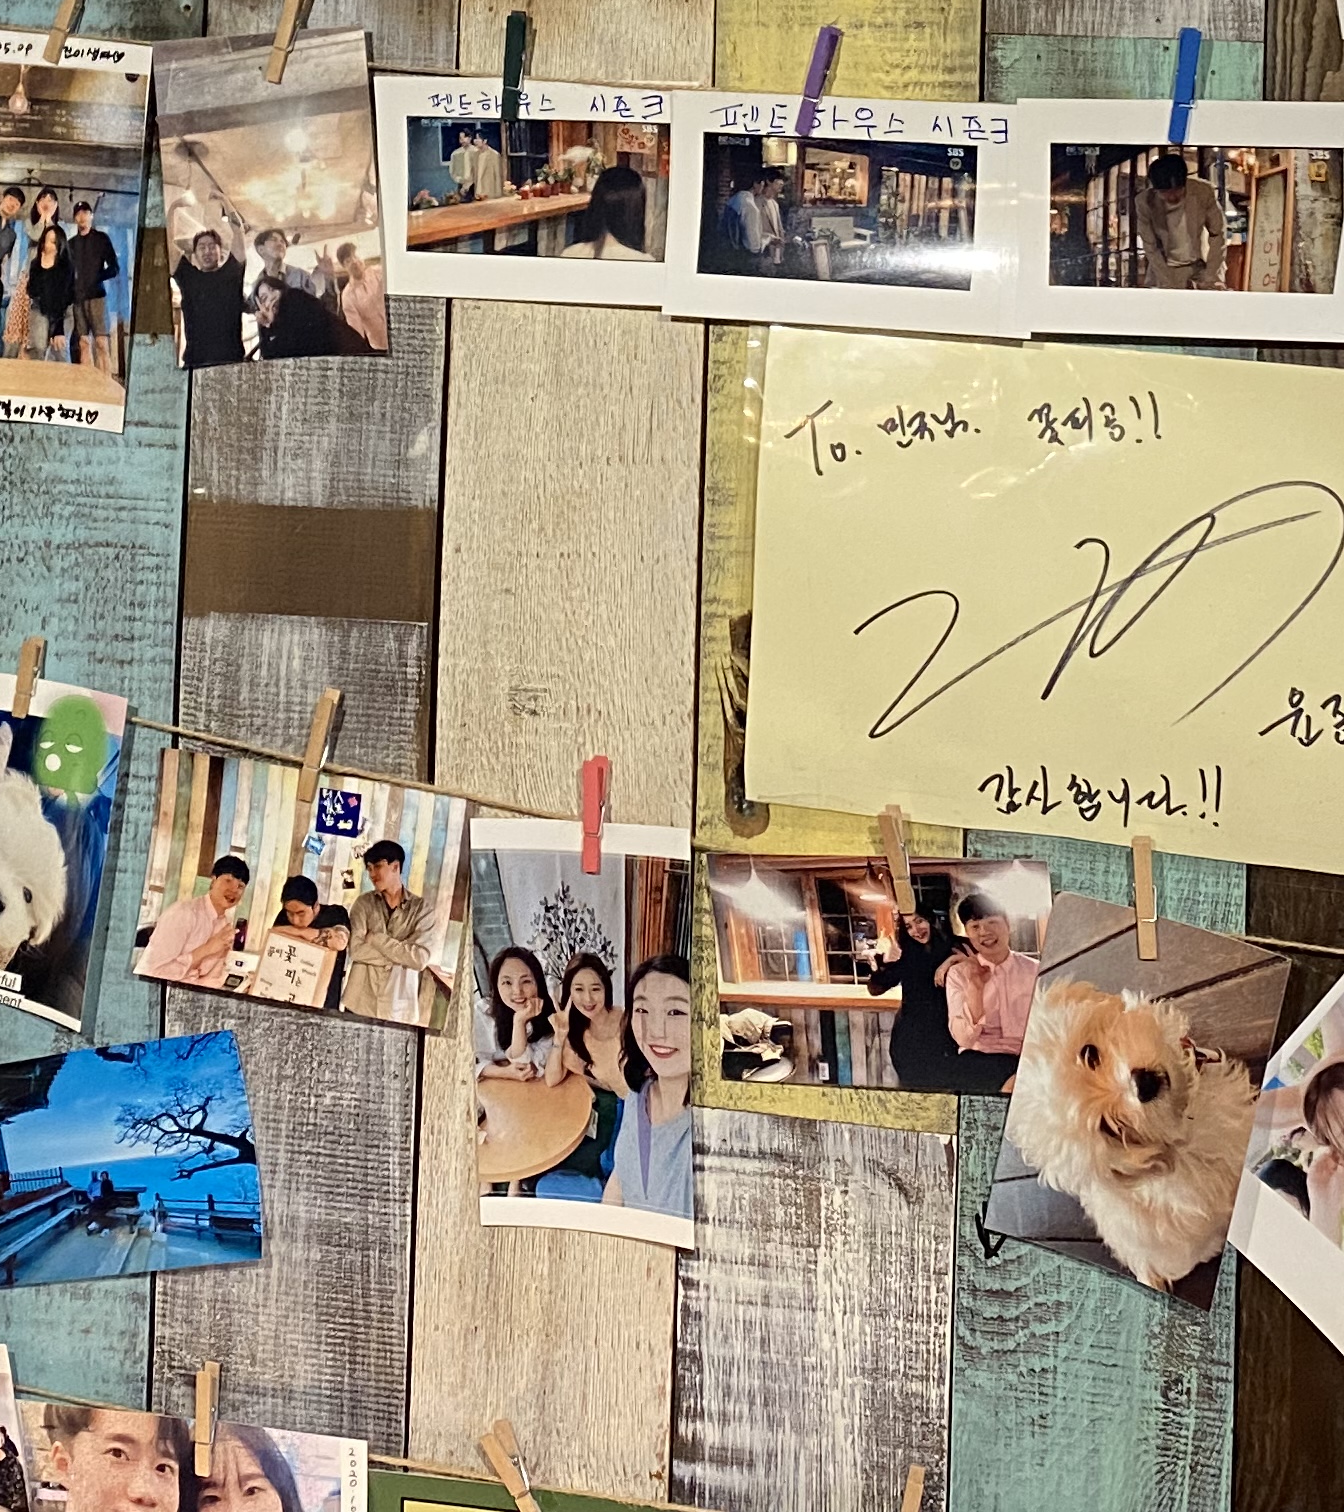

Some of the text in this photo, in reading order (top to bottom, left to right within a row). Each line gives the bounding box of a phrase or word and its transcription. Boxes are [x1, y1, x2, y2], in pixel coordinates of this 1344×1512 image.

[641, 124, 658, 134] SBS
[947, 147, 964, 157] SBS
[784, 399, 862, 477] To.
